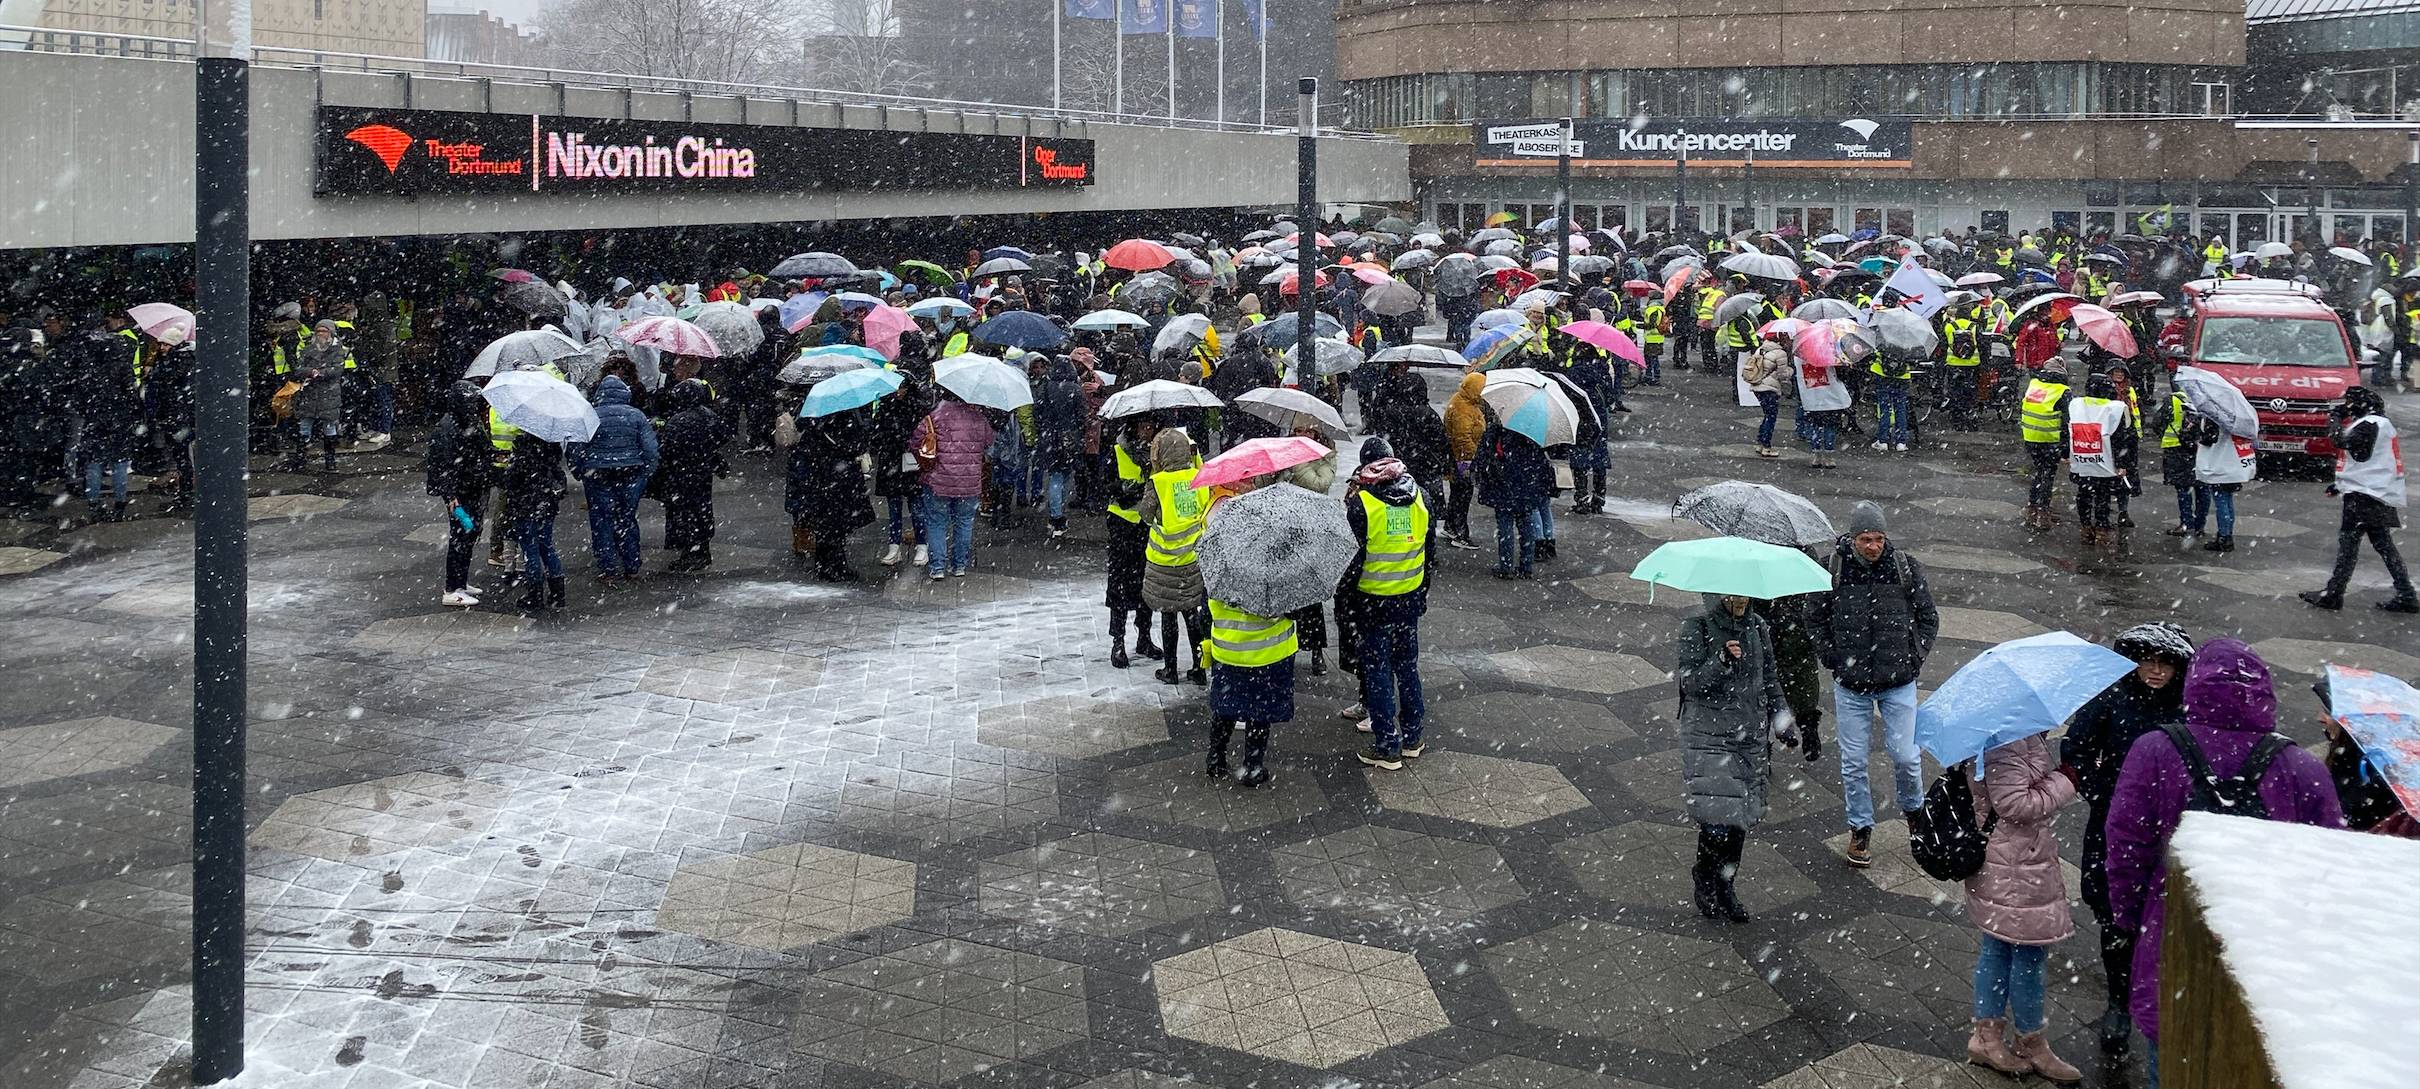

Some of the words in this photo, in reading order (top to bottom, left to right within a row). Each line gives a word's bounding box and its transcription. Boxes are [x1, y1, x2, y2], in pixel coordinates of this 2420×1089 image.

[1493, 128, 1560, 140] THEATERKASS
[1619, 129, 1796, 150] Kundencenter
[426, 139, 482, 157] Theater
[1835, 143, 1868, 151] Theater
[1848, 148, 1891, 158] Dortmund
[548, 132, 643, 178] Nixon
[646, 135, 672, 177] in
[676, 135, 755, 178] China
[1035, 146, 1056, 165] Oper
[449, 157, 521, 174] Dortmund
[1044, 162, 1086, 178] Dortmund
[2231, 376, 2284, 386] ver
[2073, 440, 2091, 449] ver
[2091, 441, 2101, 449] di
[2073, 454, 2105, 463] Streik
[1387, 517, 1412, 530] MEHR
